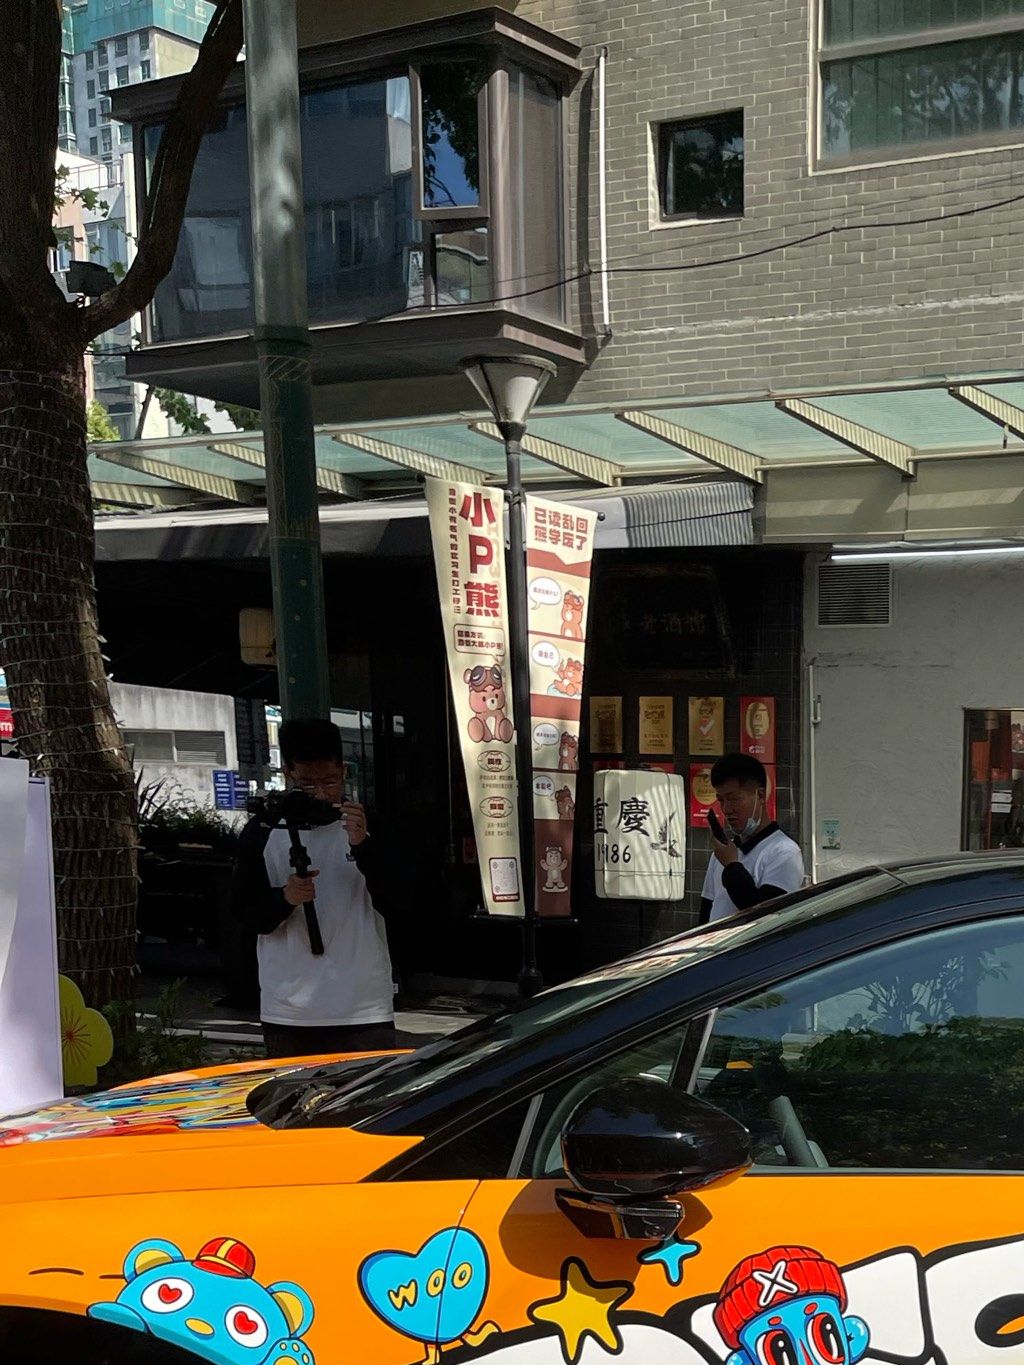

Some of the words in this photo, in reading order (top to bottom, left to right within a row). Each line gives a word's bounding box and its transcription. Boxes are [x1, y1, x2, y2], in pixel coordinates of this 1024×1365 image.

[534, 506, 588, 535] 已读乱回
[458, 491, 500, 617] 小P熊
[387, 1261, 473, 1311] WOO
